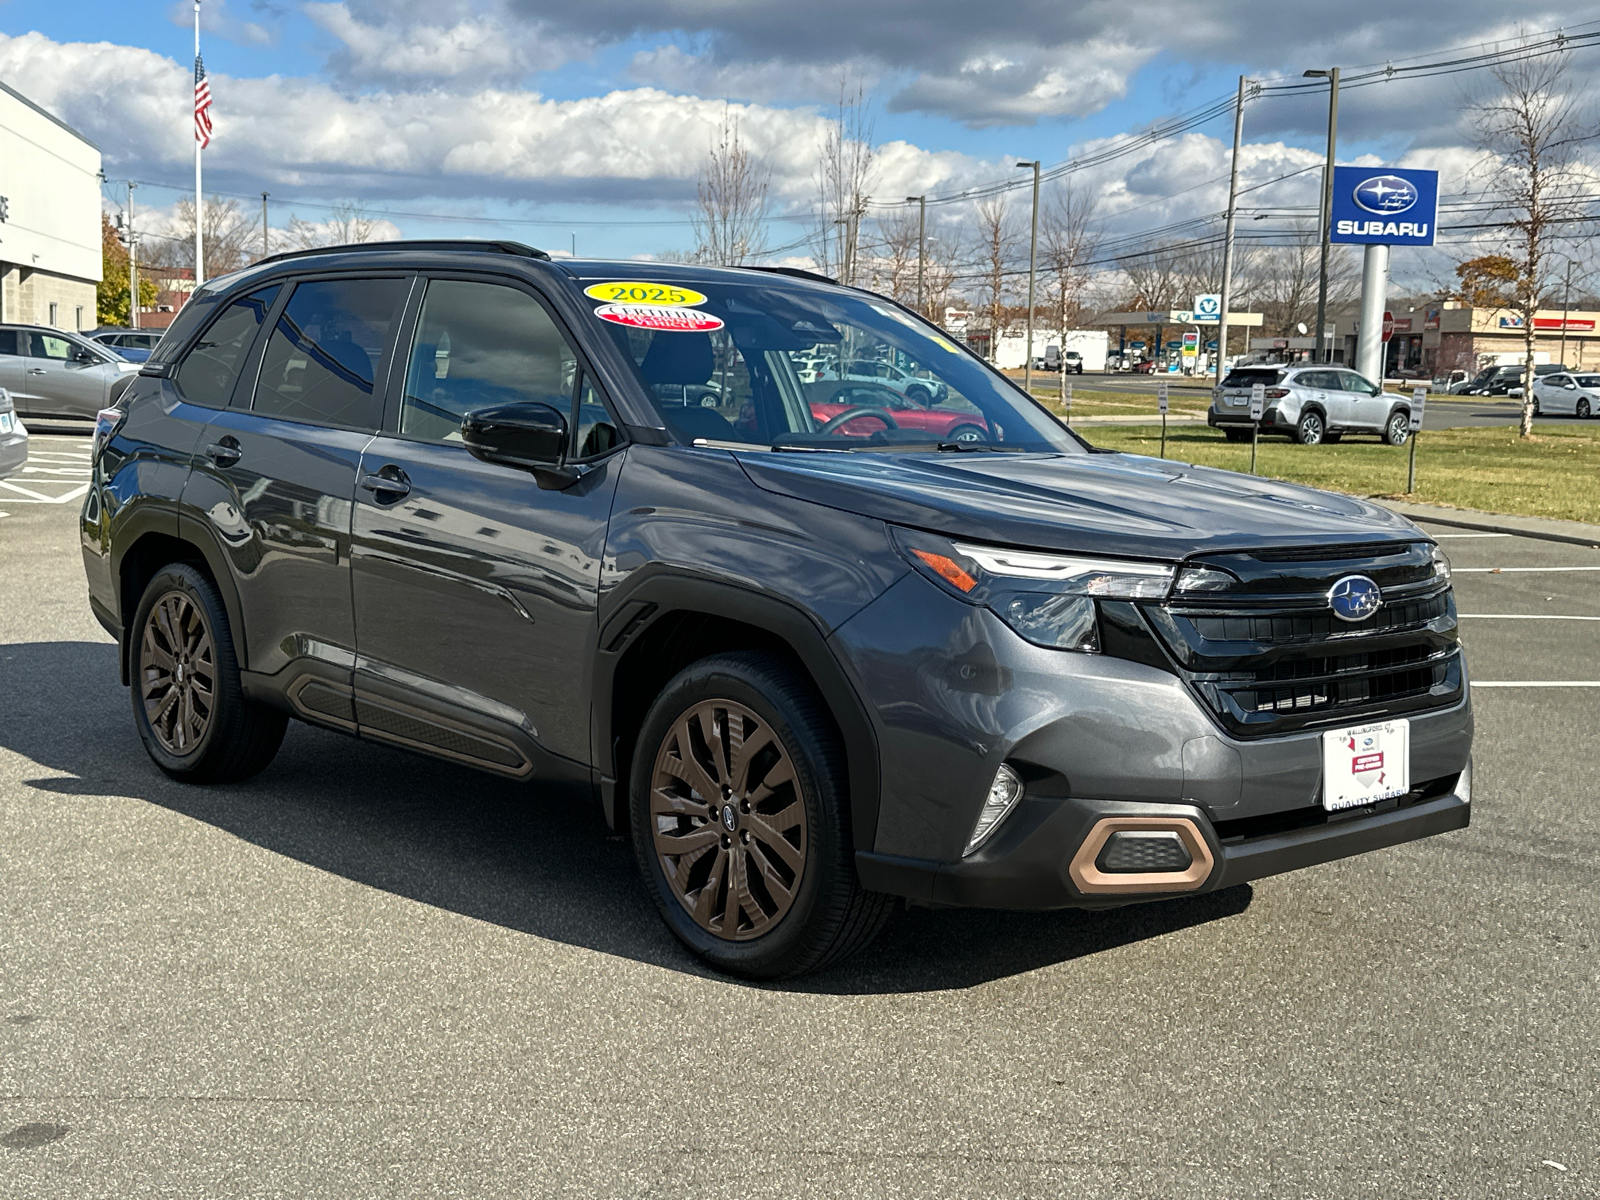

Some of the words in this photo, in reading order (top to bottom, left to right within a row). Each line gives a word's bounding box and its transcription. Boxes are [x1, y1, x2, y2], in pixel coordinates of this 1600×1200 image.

[1336, 220, 1429, 238] SUBARU
[609, 287, 687, 303] 2025
[608, 307, 707, 321] CERTIFIED
[634, 318, 698, 329] VEHICLE
[1331, 796, 1370, 810] QUALITY
[1373, 788, 1407, 801] SUBARU
